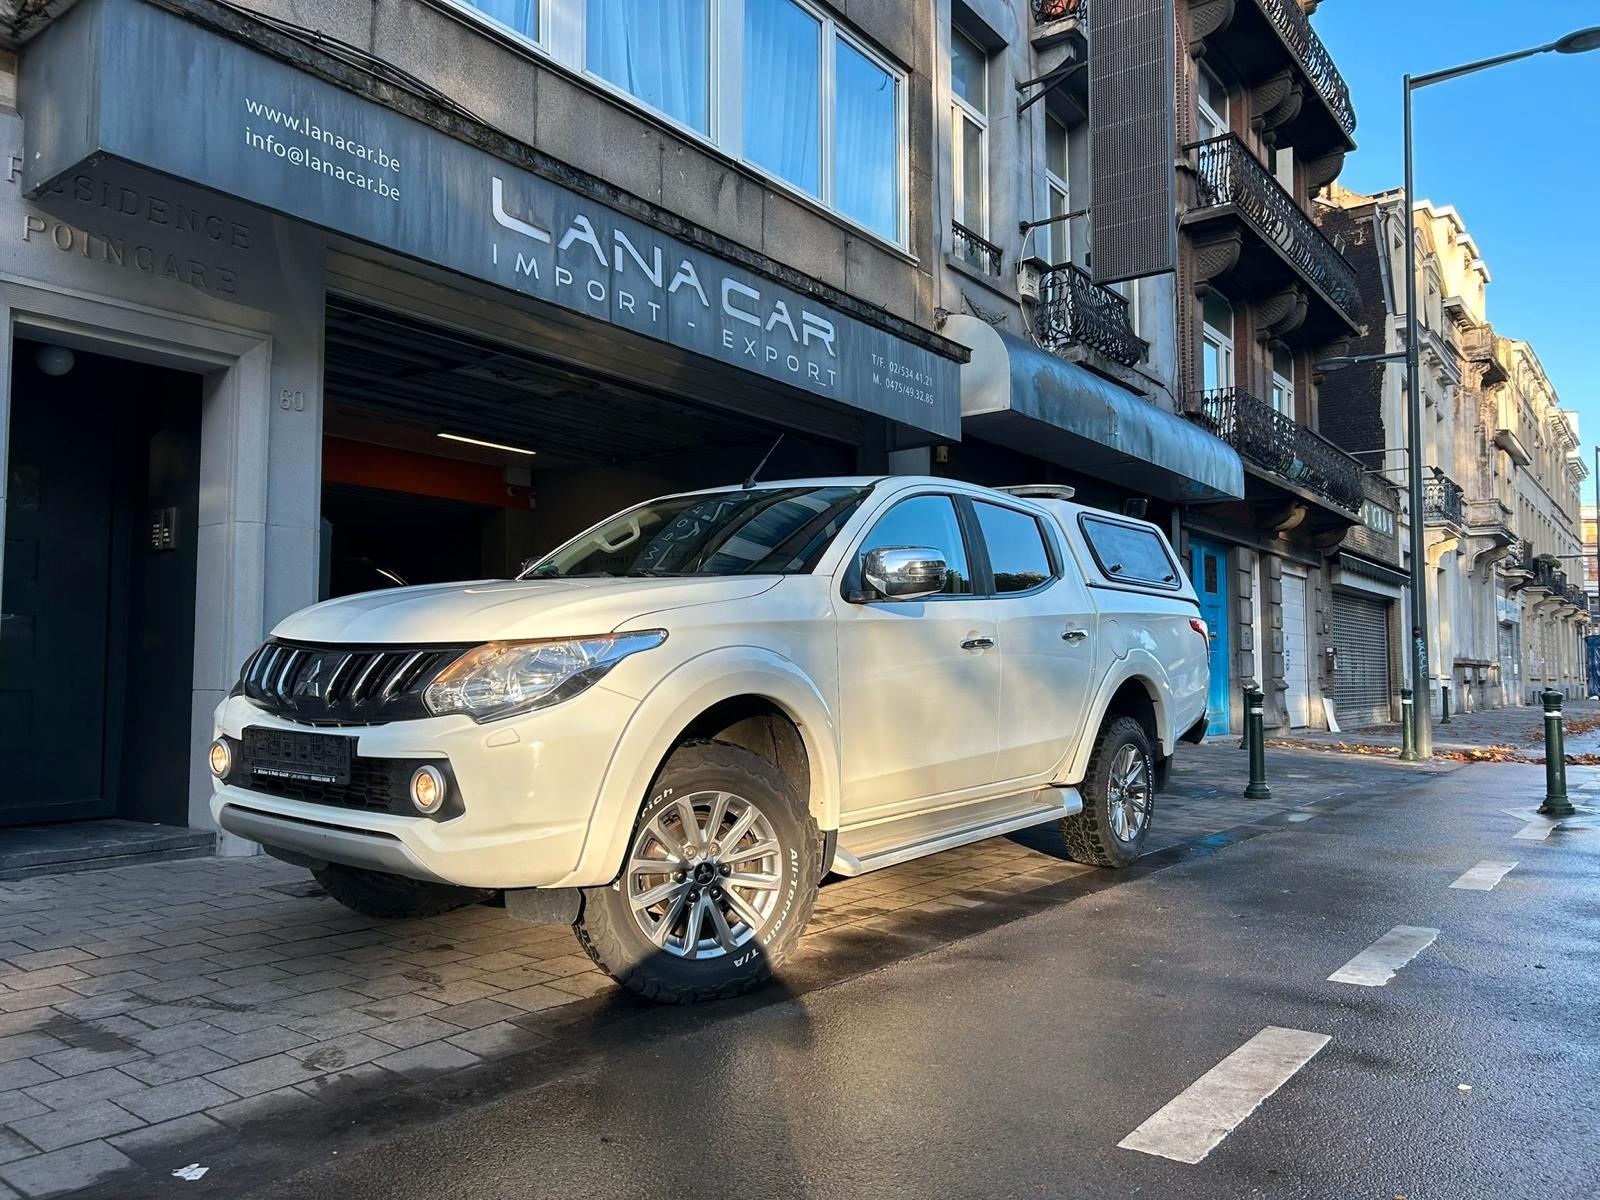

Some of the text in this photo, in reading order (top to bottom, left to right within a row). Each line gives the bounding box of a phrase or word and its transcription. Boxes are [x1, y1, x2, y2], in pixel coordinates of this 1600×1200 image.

[245, 98, 400, 173] www.lanacar.be
[245, 127, 400, 201] info@lanacar.be
[493, 243, 661, 322] IMPORT
[723, 329, 837, 387] EXPORT
[733, 848, 799, 968] All-Terrain T/A
